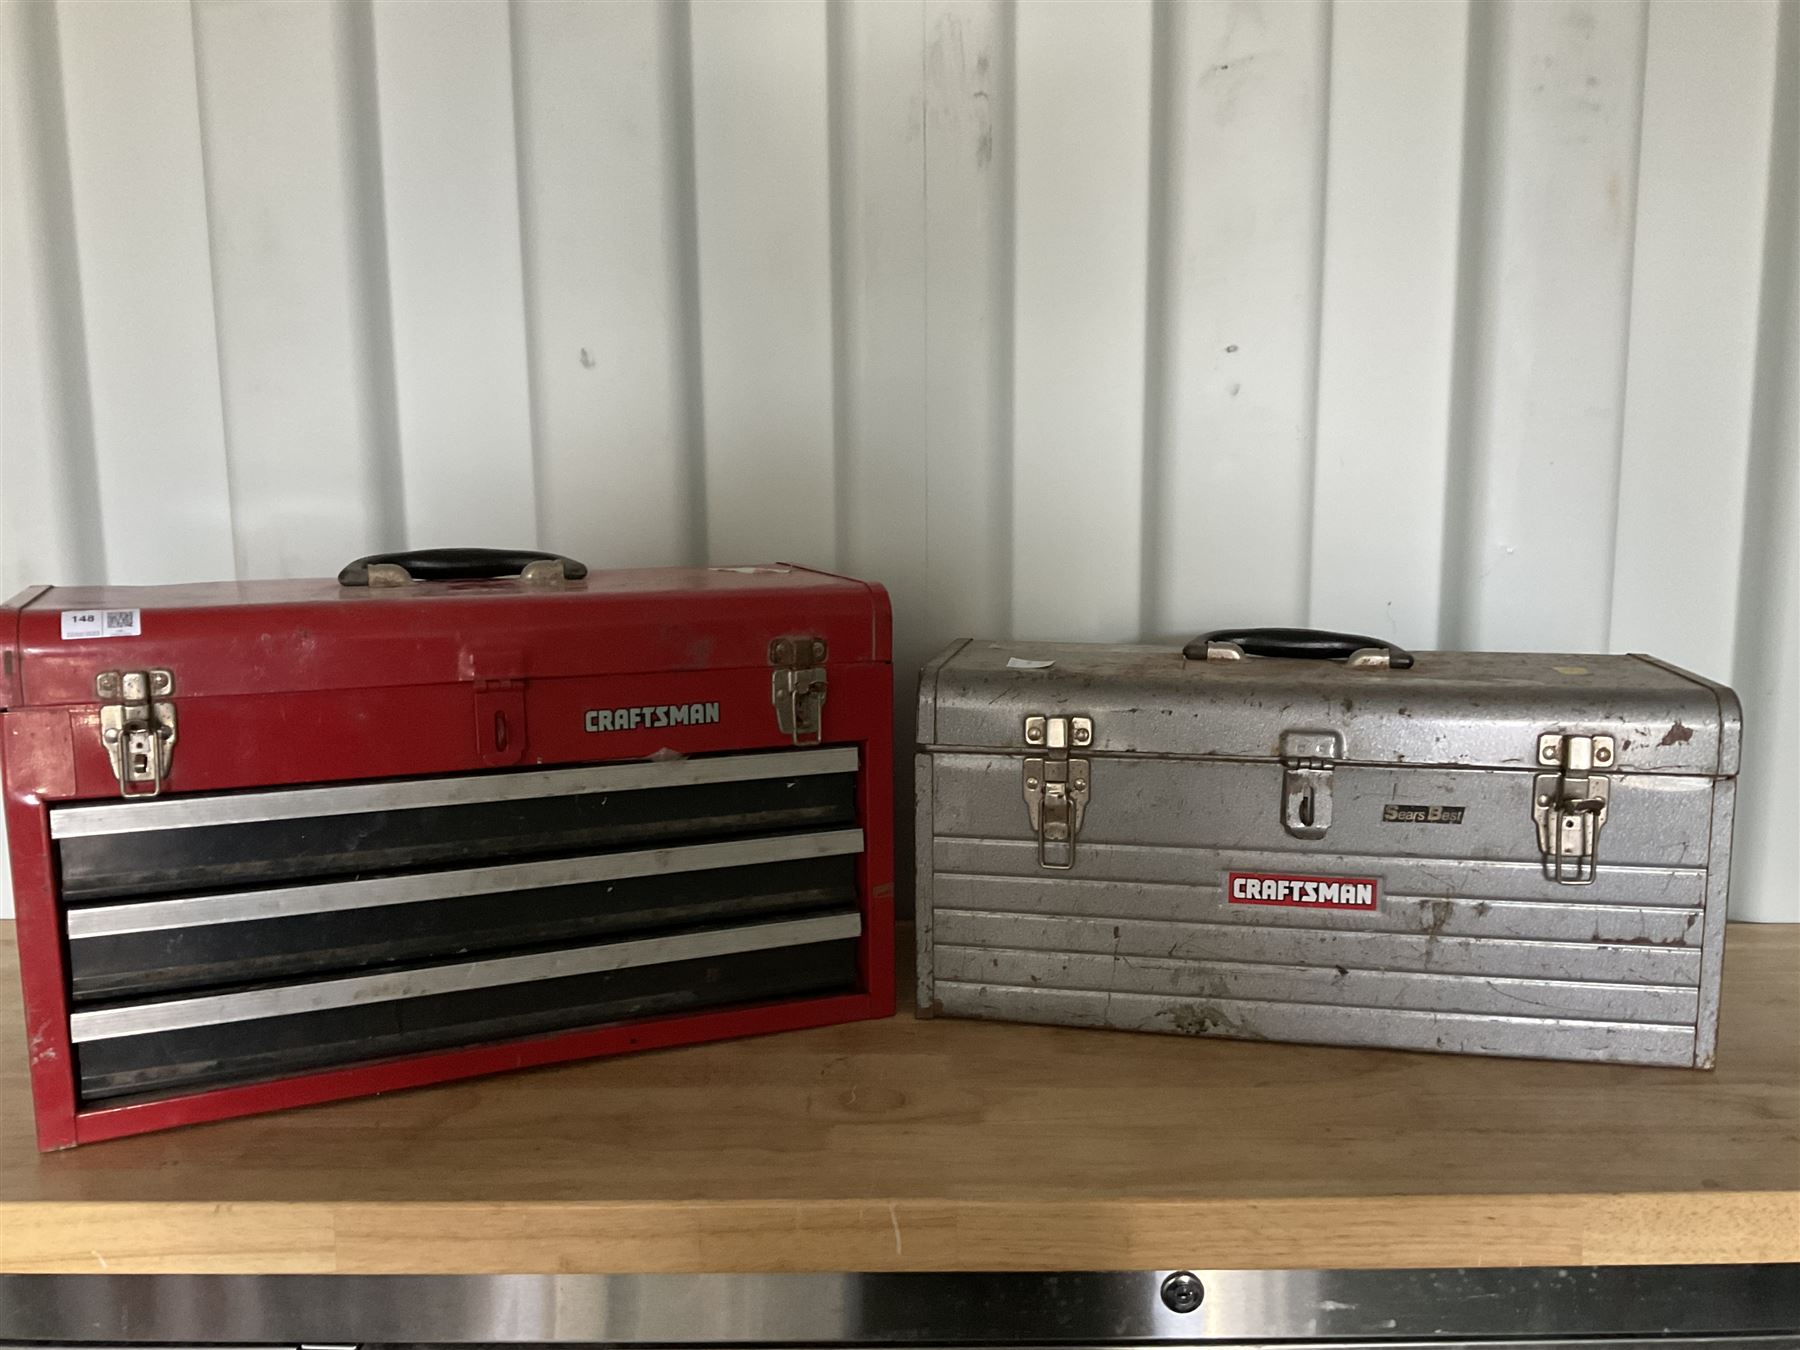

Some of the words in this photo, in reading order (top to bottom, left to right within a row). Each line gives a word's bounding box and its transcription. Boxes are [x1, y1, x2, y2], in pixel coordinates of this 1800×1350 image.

[72, 615, 95, 623] 148
[585, 702, 719, 732] CRAFTSMAN
[1384, 805, 1425, 821] Sears
[1427, 806, 1463, 822] Best
[1233, 878, 1372, 905] CRAFTSMAN
